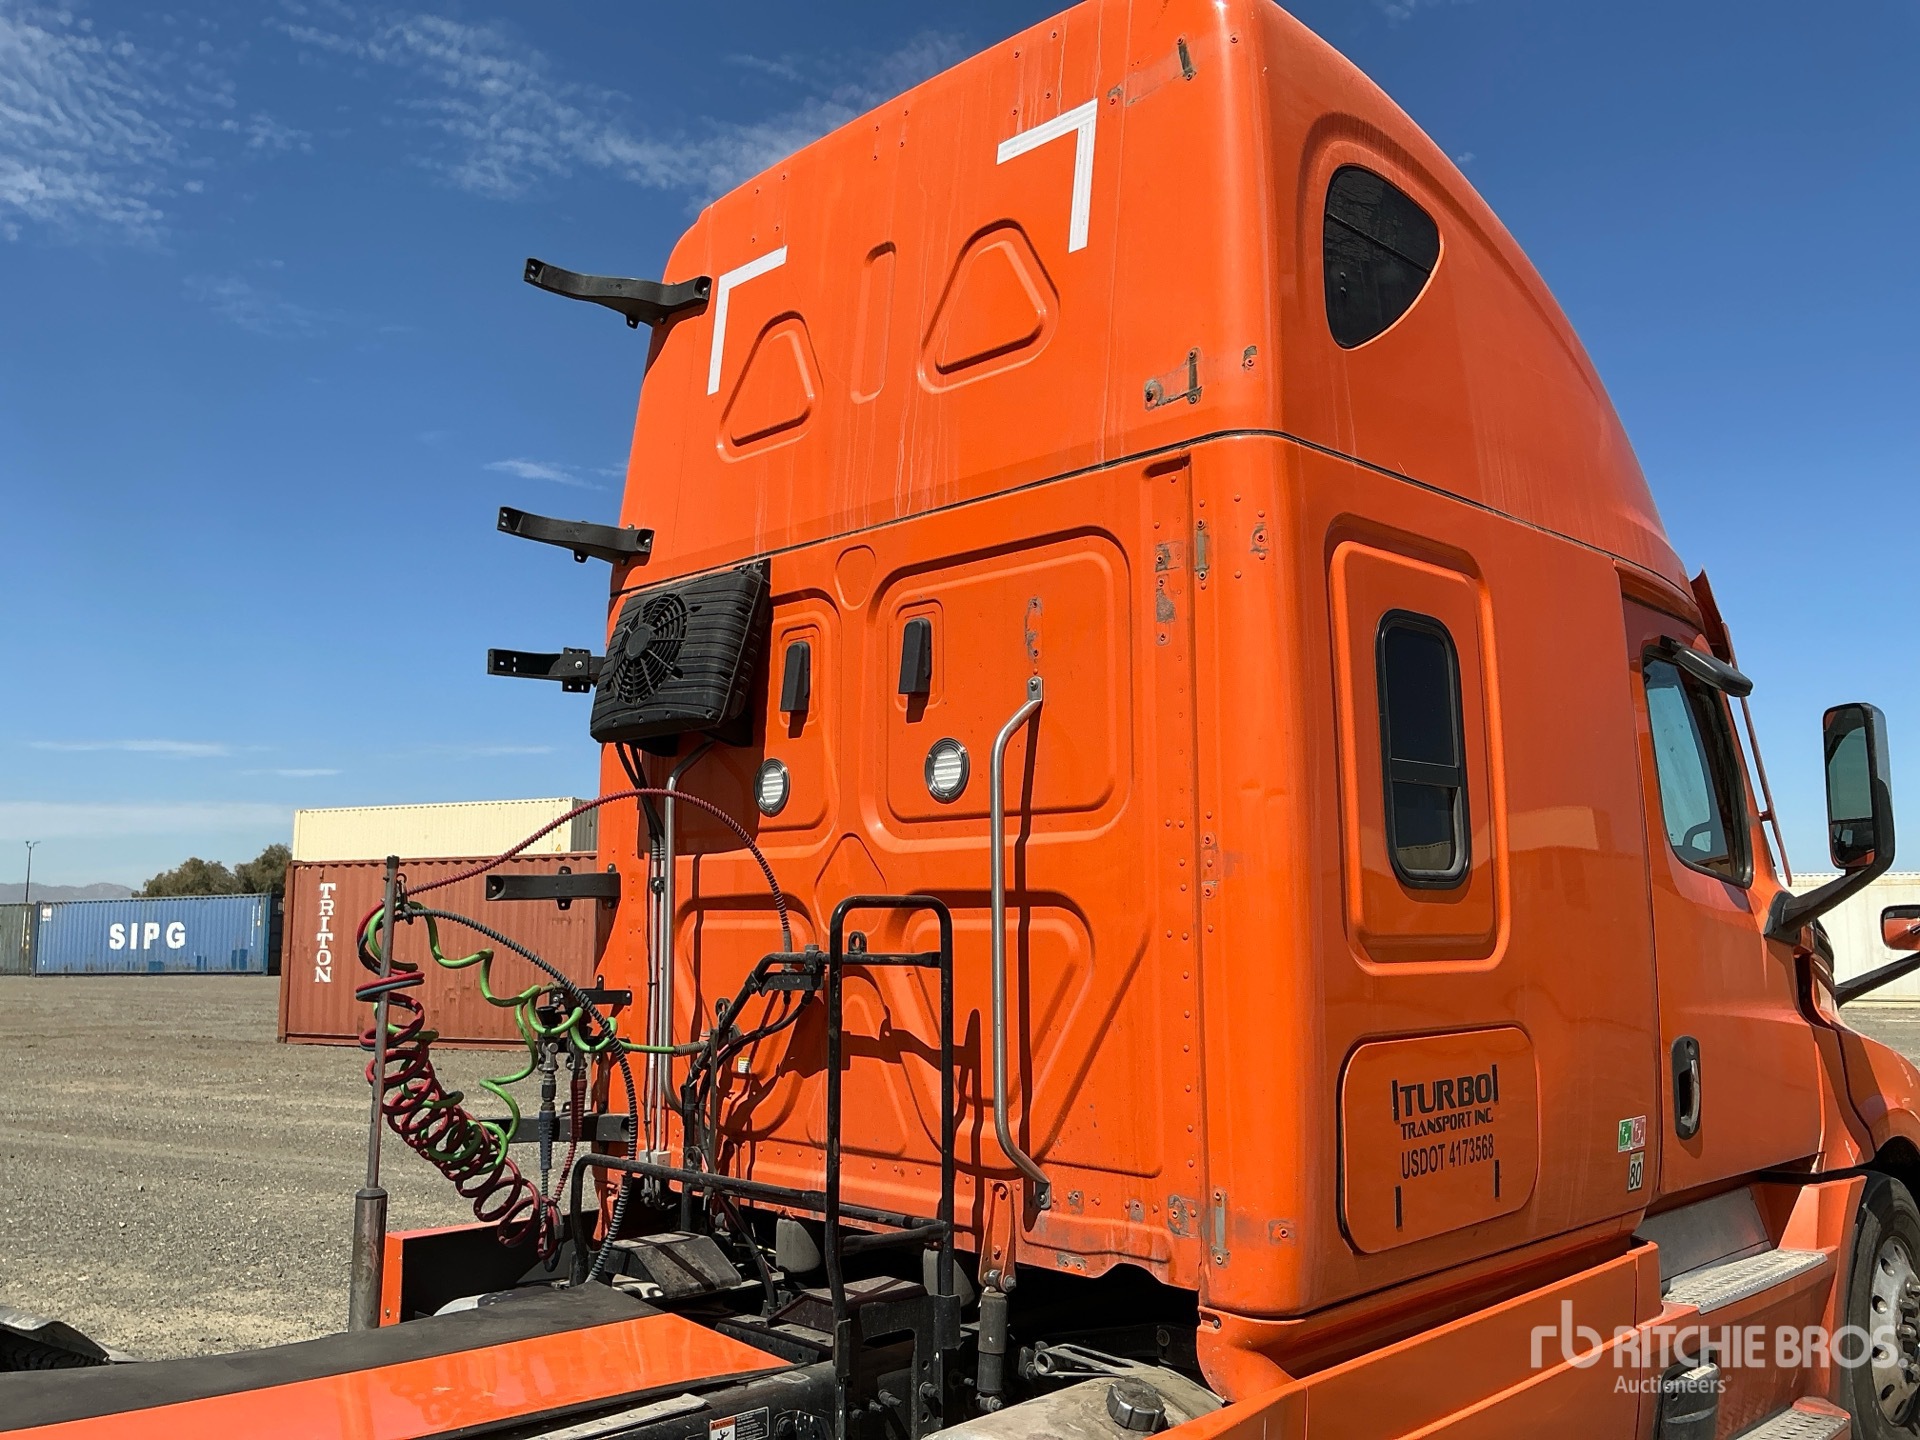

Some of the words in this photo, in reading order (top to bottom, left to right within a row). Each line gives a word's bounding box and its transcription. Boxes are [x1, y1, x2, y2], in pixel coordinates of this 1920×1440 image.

[109, 921, 186, 950] SIPG
[314, 882, 336, 983] TRITON
[1399, 1073, 1492, 1117] TURBO
[1401, 1111, 1472, 1140] TRANSPORT
[1402, 1143, 1446, 1180] USDOT
[1449, 1133, 1494, 1168] 4173568
